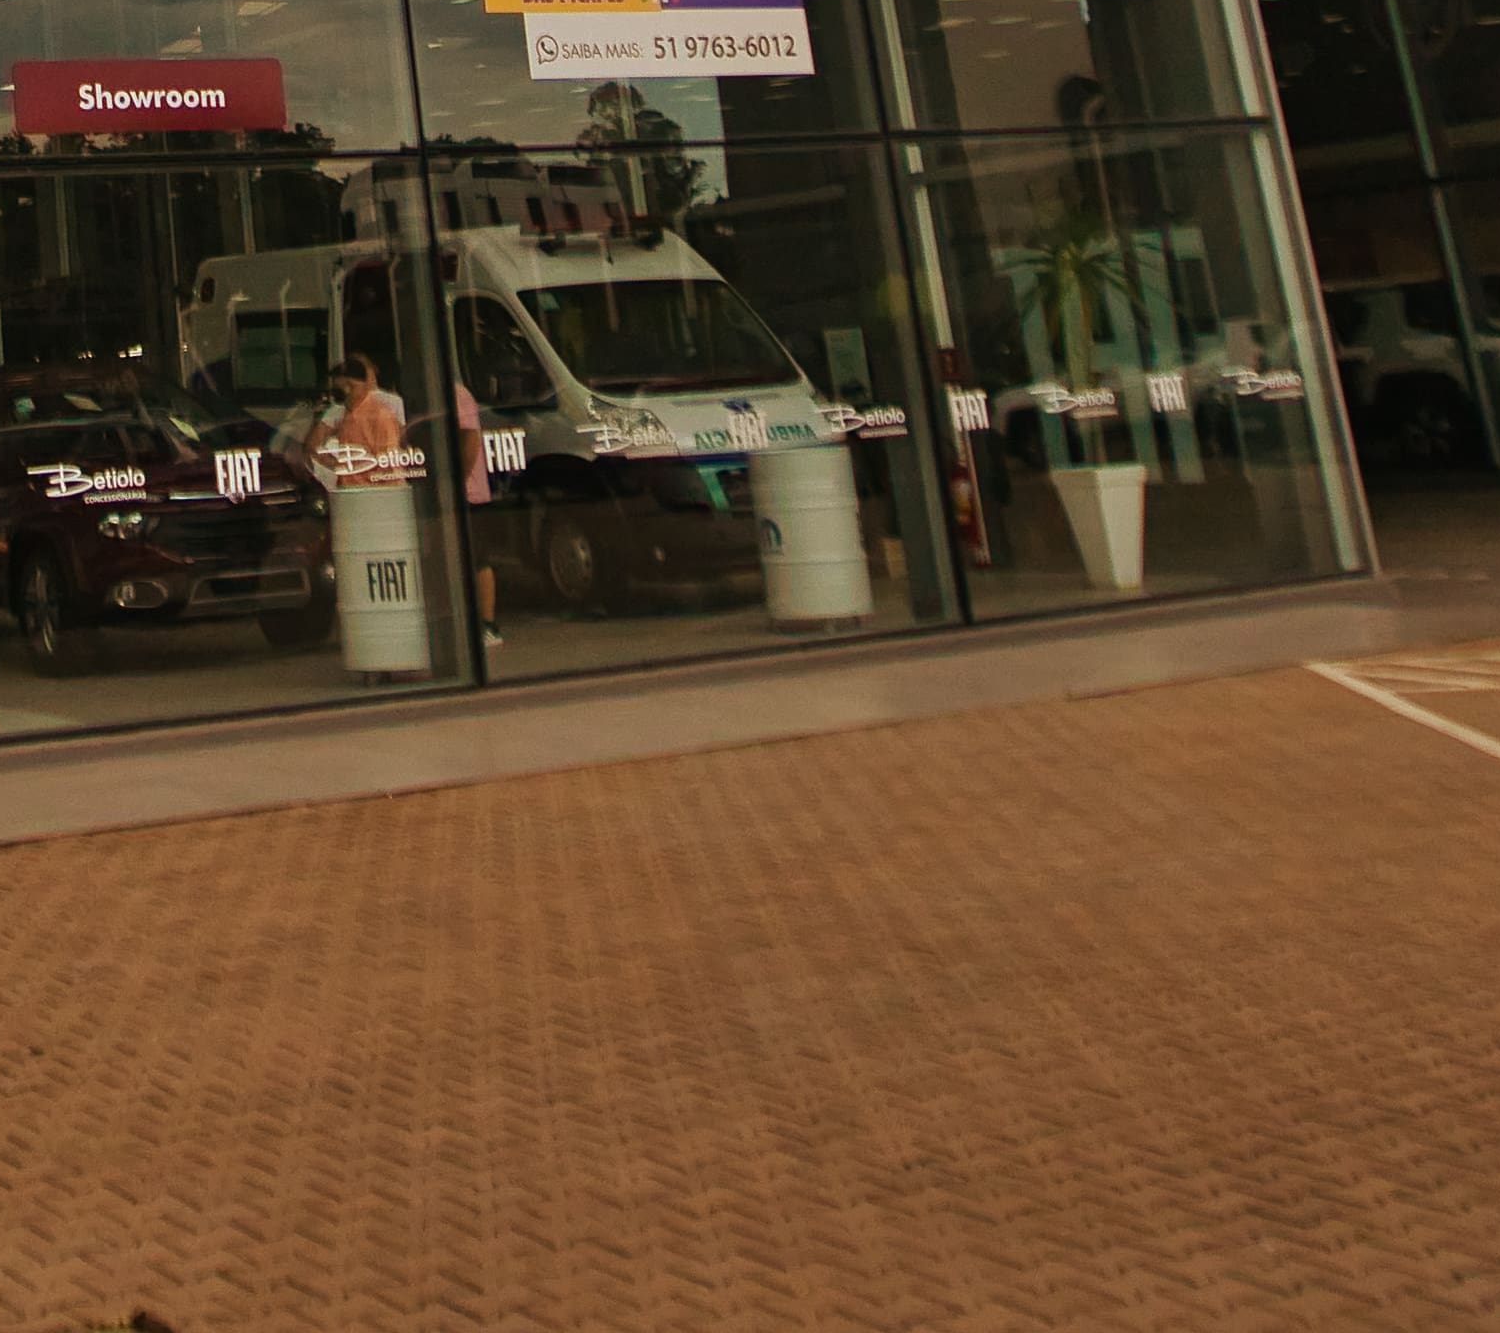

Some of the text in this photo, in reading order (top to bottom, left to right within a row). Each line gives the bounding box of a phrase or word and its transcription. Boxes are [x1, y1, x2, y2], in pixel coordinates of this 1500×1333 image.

[561, 44, 602, 60] SAIBA
[653, 36, 678, 60] 51
[684, 35, 798, 59] 9763-6012
[79, 83, 226, 111] Showroom
[815, 405, 907, 434] Betiolo
[950, 389, 990, 432] FIAT
[316, 444, 427, 476] Betiolo
[482, 427, 527, 474] FIAT
[27, 462, 148, 499] Betiolo
[214, 448, 263, 495] FIAT
[365, 557, 409, 604] FIAT
